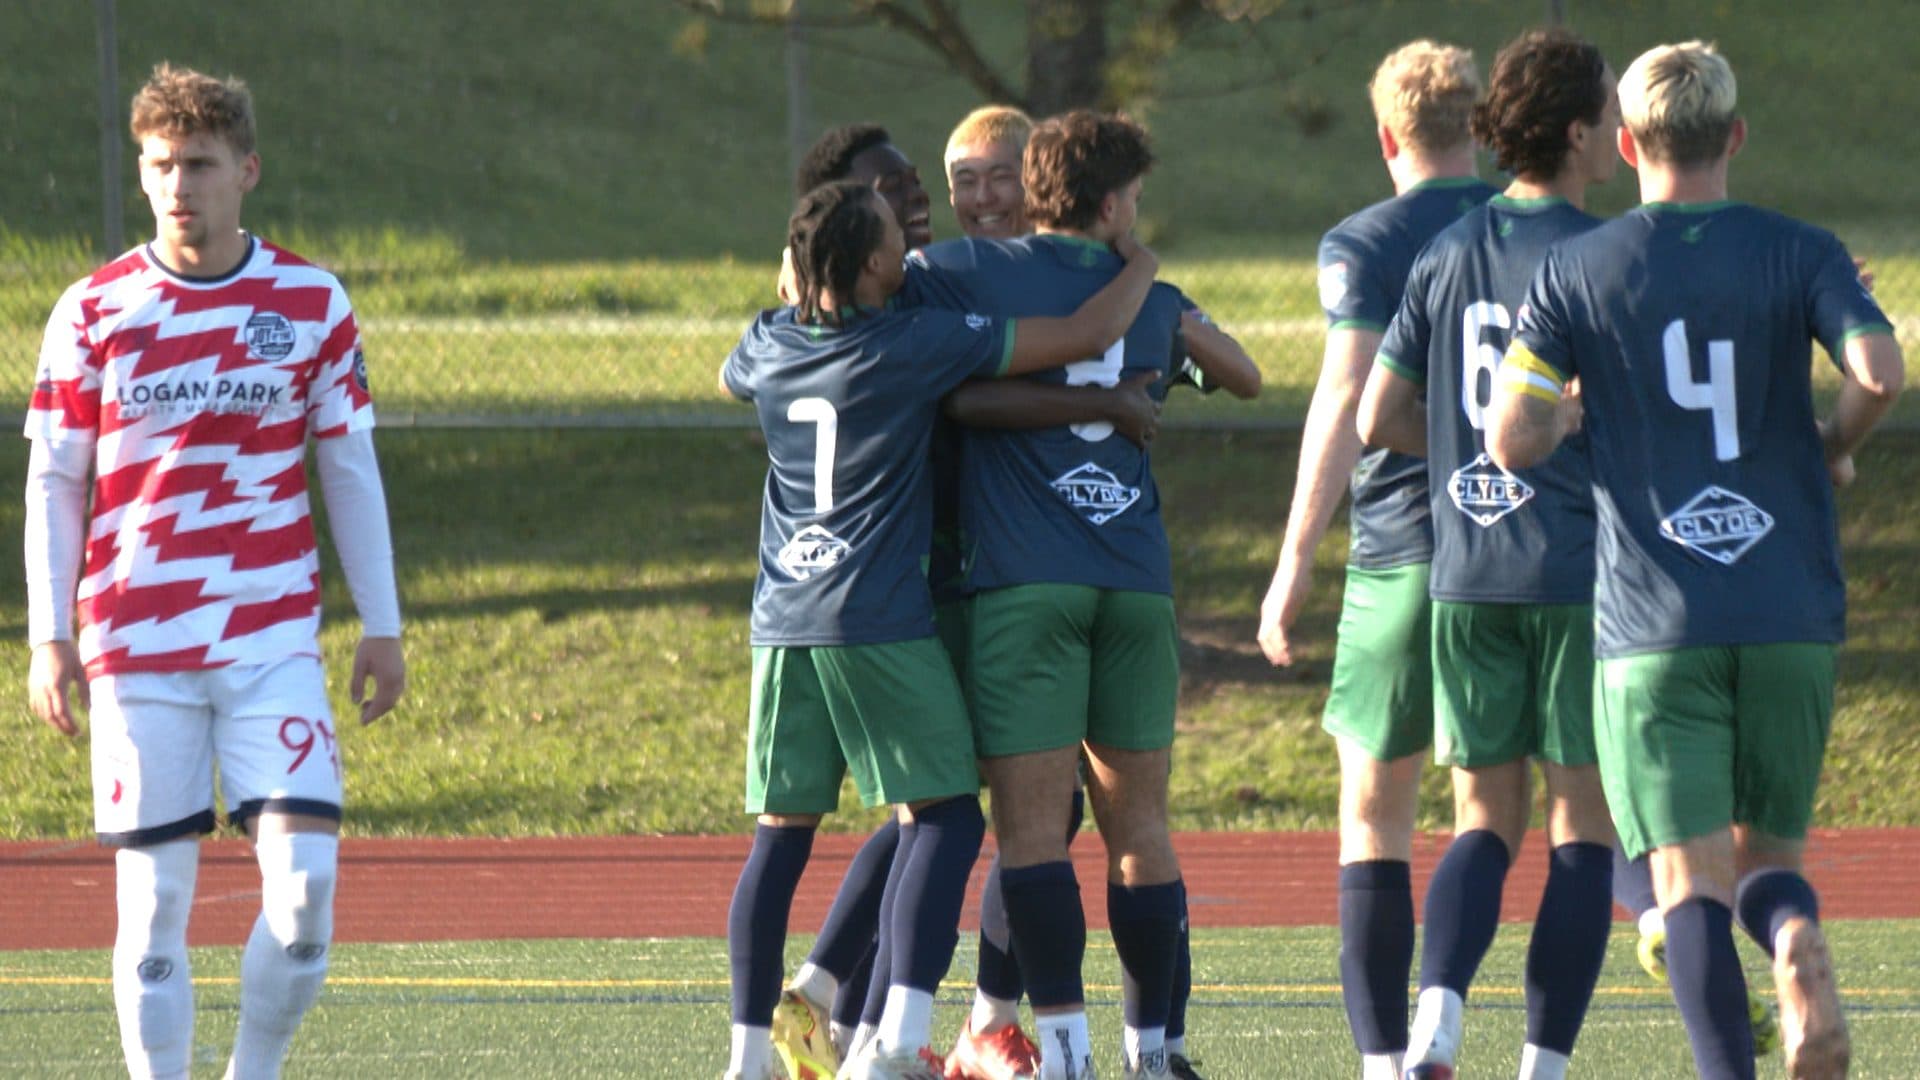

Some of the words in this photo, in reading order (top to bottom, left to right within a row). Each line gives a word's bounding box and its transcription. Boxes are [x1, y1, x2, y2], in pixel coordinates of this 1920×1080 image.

[118, 382, 209, 405] LOGAN
[216, 380, 283, 404] PARK
[1662, 318, 1740, 462] 4
[1677, 508, 1764, 538] CLYDE
